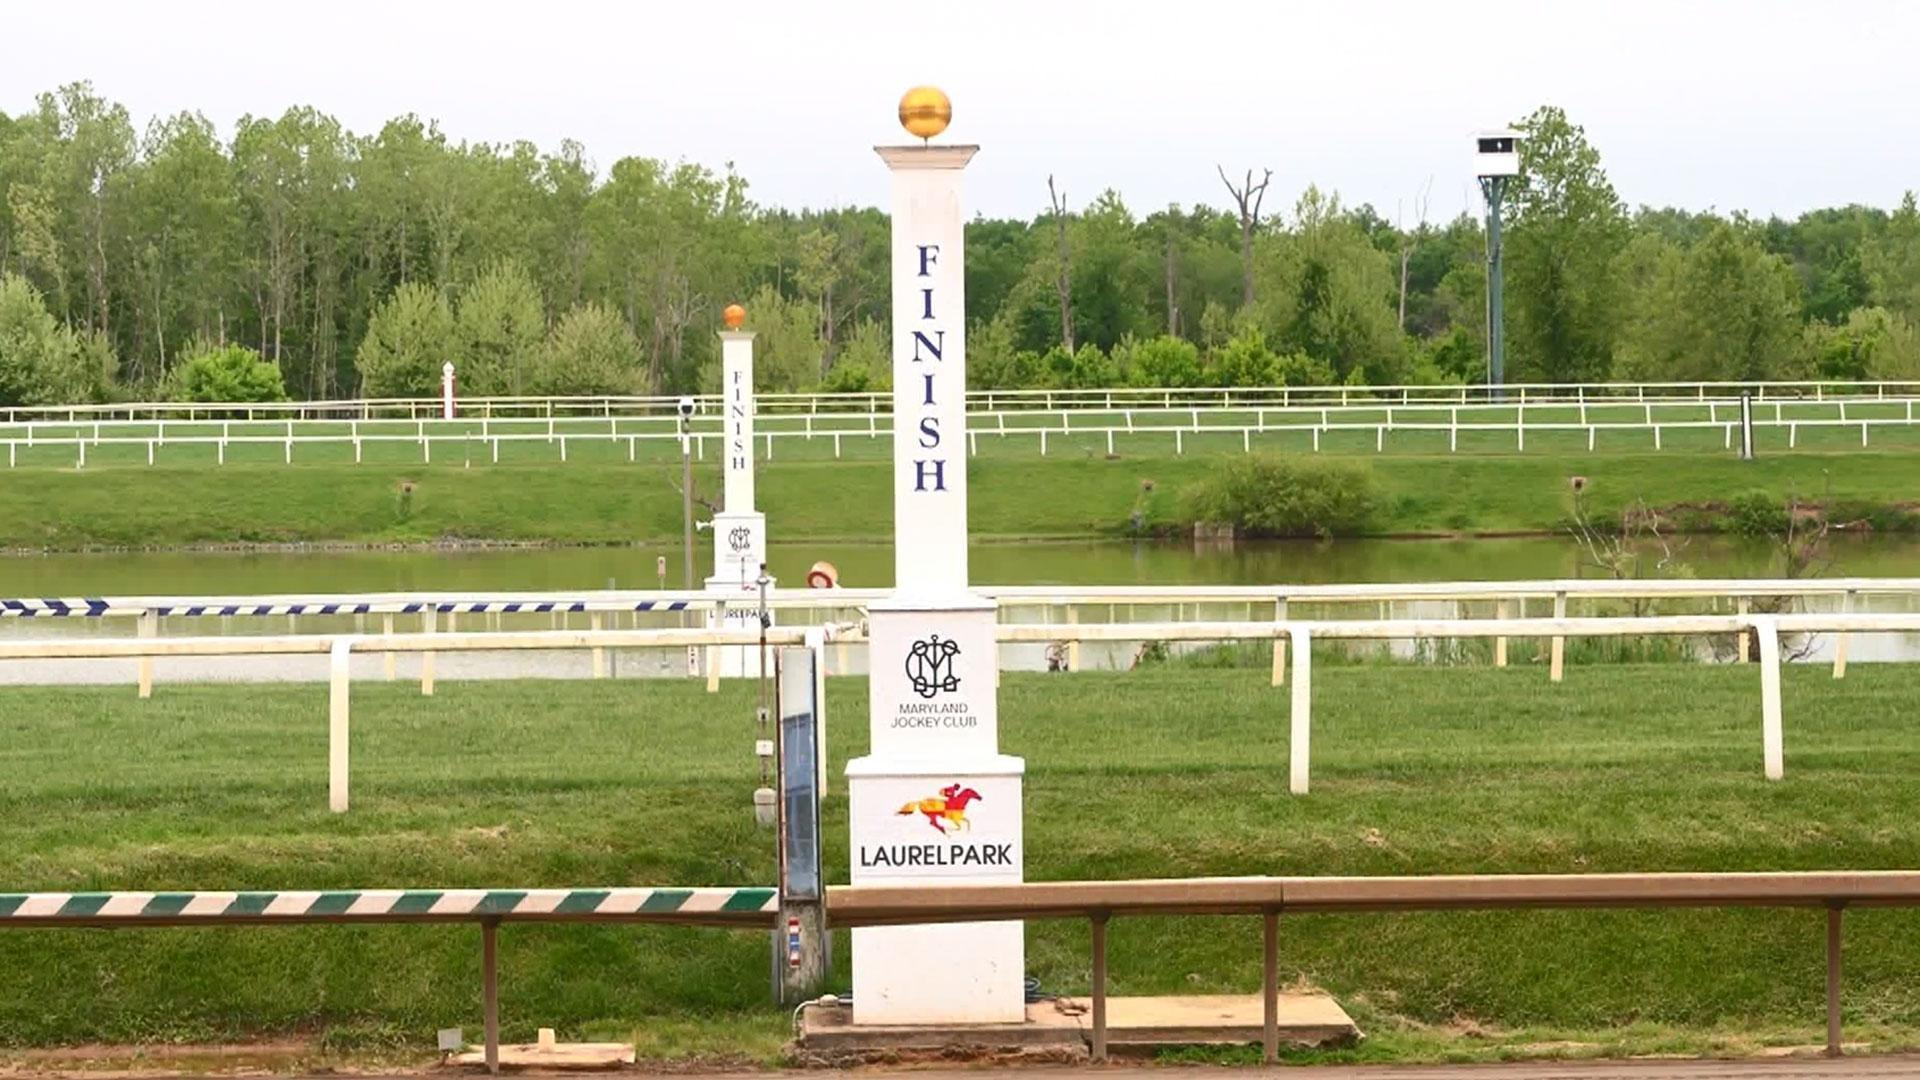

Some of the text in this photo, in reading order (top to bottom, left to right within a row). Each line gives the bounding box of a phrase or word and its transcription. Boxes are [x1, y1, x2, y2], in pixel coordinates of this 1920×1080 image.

[910, 245, 948, 492] FINISH
[731, 370, 744, 470] FINISH
[890, 716, 977, 728] JOCKEY CLUB
[899, 703, 969, 714] MARYLAND
